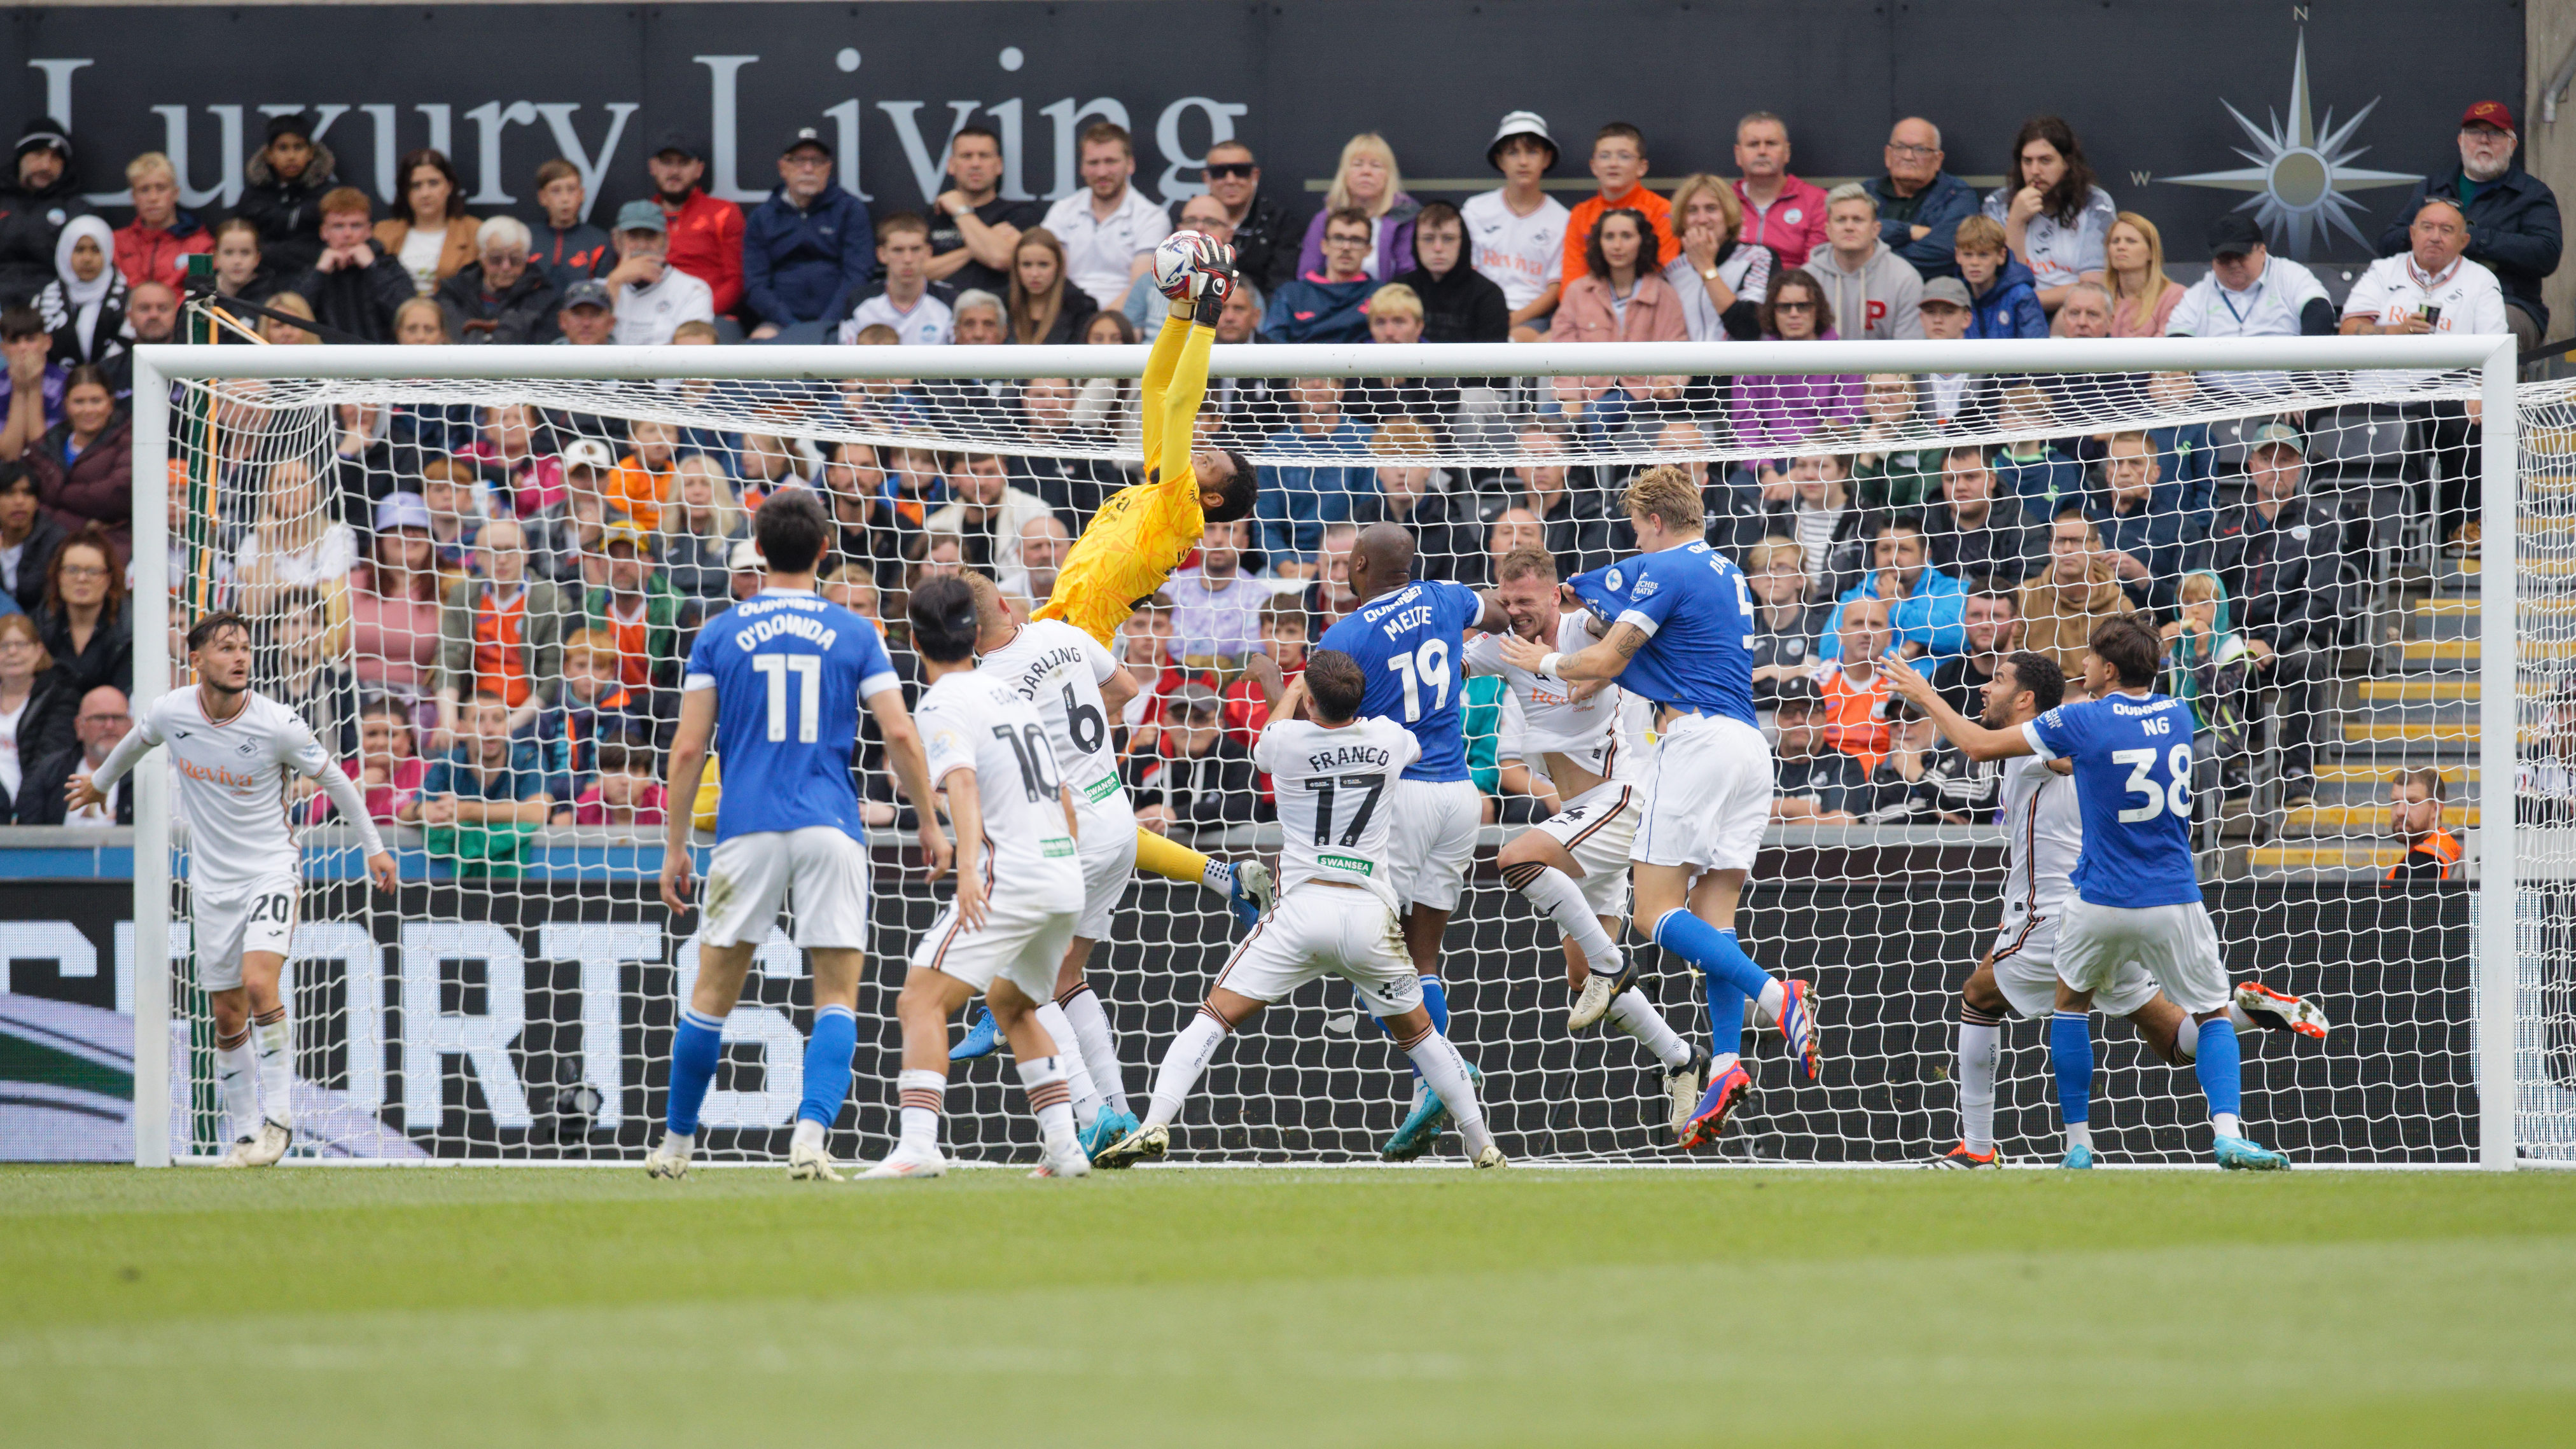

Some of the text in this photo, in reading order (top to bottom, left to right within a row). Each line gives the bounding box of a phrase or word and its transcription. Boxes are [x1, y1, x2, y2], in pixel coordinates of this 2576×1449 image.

[2293, 5, 2309, 22] N
[693, 46, 1248, 211] Living
[2129, 170, 2152, 186] W
[1865, 300, 1886, 331] P
[2388, 305, 2452, 331] Rea
[737, 597, 828, 618] QUINNBET
[1363, 585, 1423, 623] QUINNBET
[735, 613, 837, 652] O'DOWDA
[1383, 606, 1432, 642] MEITE
[1019, 646, 1082, 702] DARLING
[1388, 637, 1451, 723] 19
[752, 653, 821, 743] 11
[2112, 698, 2179, 716] QUINNBET
[1061, 681, 1105, 755] 6
[2140, 716, 2171, 737] NG
[179, 757, 253, 787] Reviva
[991, 723, 1062, 803] 10
[1309, 745, 1389, 773] FRANCO
[1085, 775, 1117, 799] SWANSA
[2112, 743, 2193, 823] 38
[1304, 773, 1386, 847] 17
[1563, 805, 1589, 821] 4
[1320, 857, 1369, 872] SWANSEA
[249, 892, 289, 923] 20
[1393, 974, 1409, 987] FIRST
[1394, 978, 1412, 992] GRADE
